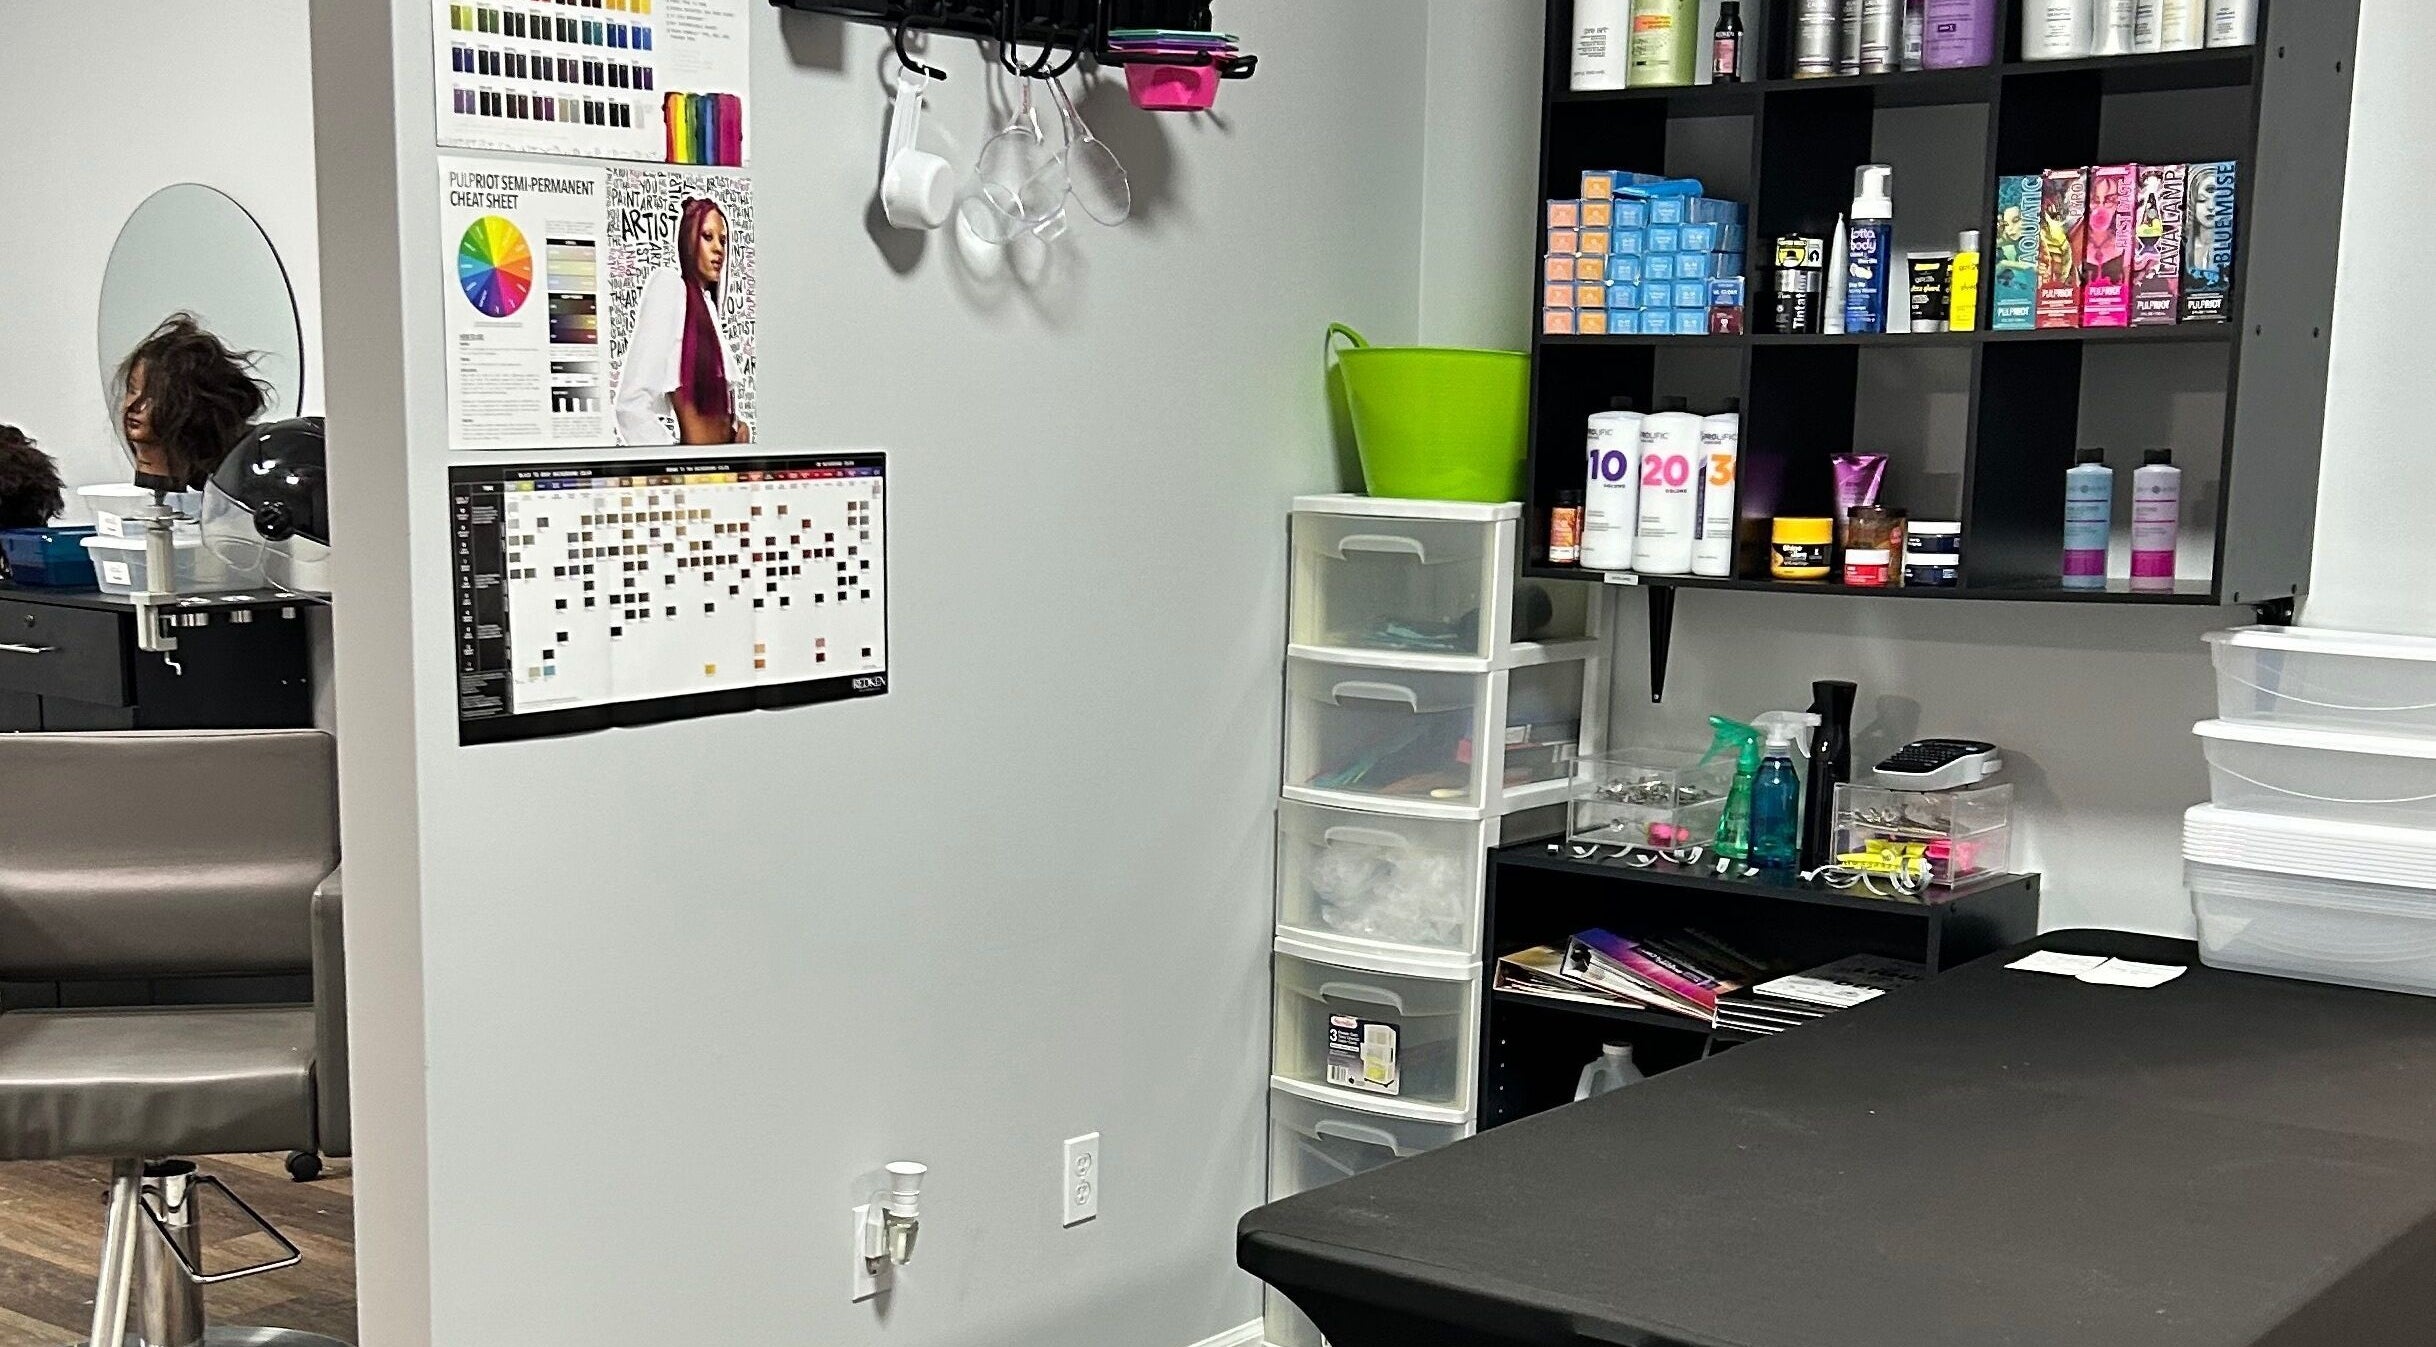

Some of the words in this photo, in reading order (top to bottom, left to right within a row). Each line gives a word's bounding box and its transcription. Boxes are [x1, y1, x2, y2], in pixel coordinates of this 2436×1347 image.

[449, 171, 500, 190] PULPRIOT
[501, 175, 595, 196] SEMI-PERMANENT
[450, 190, 484, 208] CHEAT
[486, 192, 519, 210] SHEET
[2069, 182, 2085, 217] PYRO
[2162, 169, 2183, 225] LAMP
[2214, 164, 2235, 218] MUSE
[621, 207, 679, 243] ARTIST
[2018, 177, 2042, 265] AQUATIC
[2159, 230, 2179, 277] LAVA
[2213, 220, 2232, 266] BLUE
[2187, 299, 2222, 310] PULPRIOT
[1588, 428, 1614, 437] ROLIFIC
[1640, 432, 1669, 440] ROLIFIC
[1590, 449, 1628, 482] 10
[1642, 454, 1689, 487] 20
[1709, 453, 1737, 486] 3
[852, 676, 887, 690] REDKEN
[1329, 1028, 1338, 1042] 3
